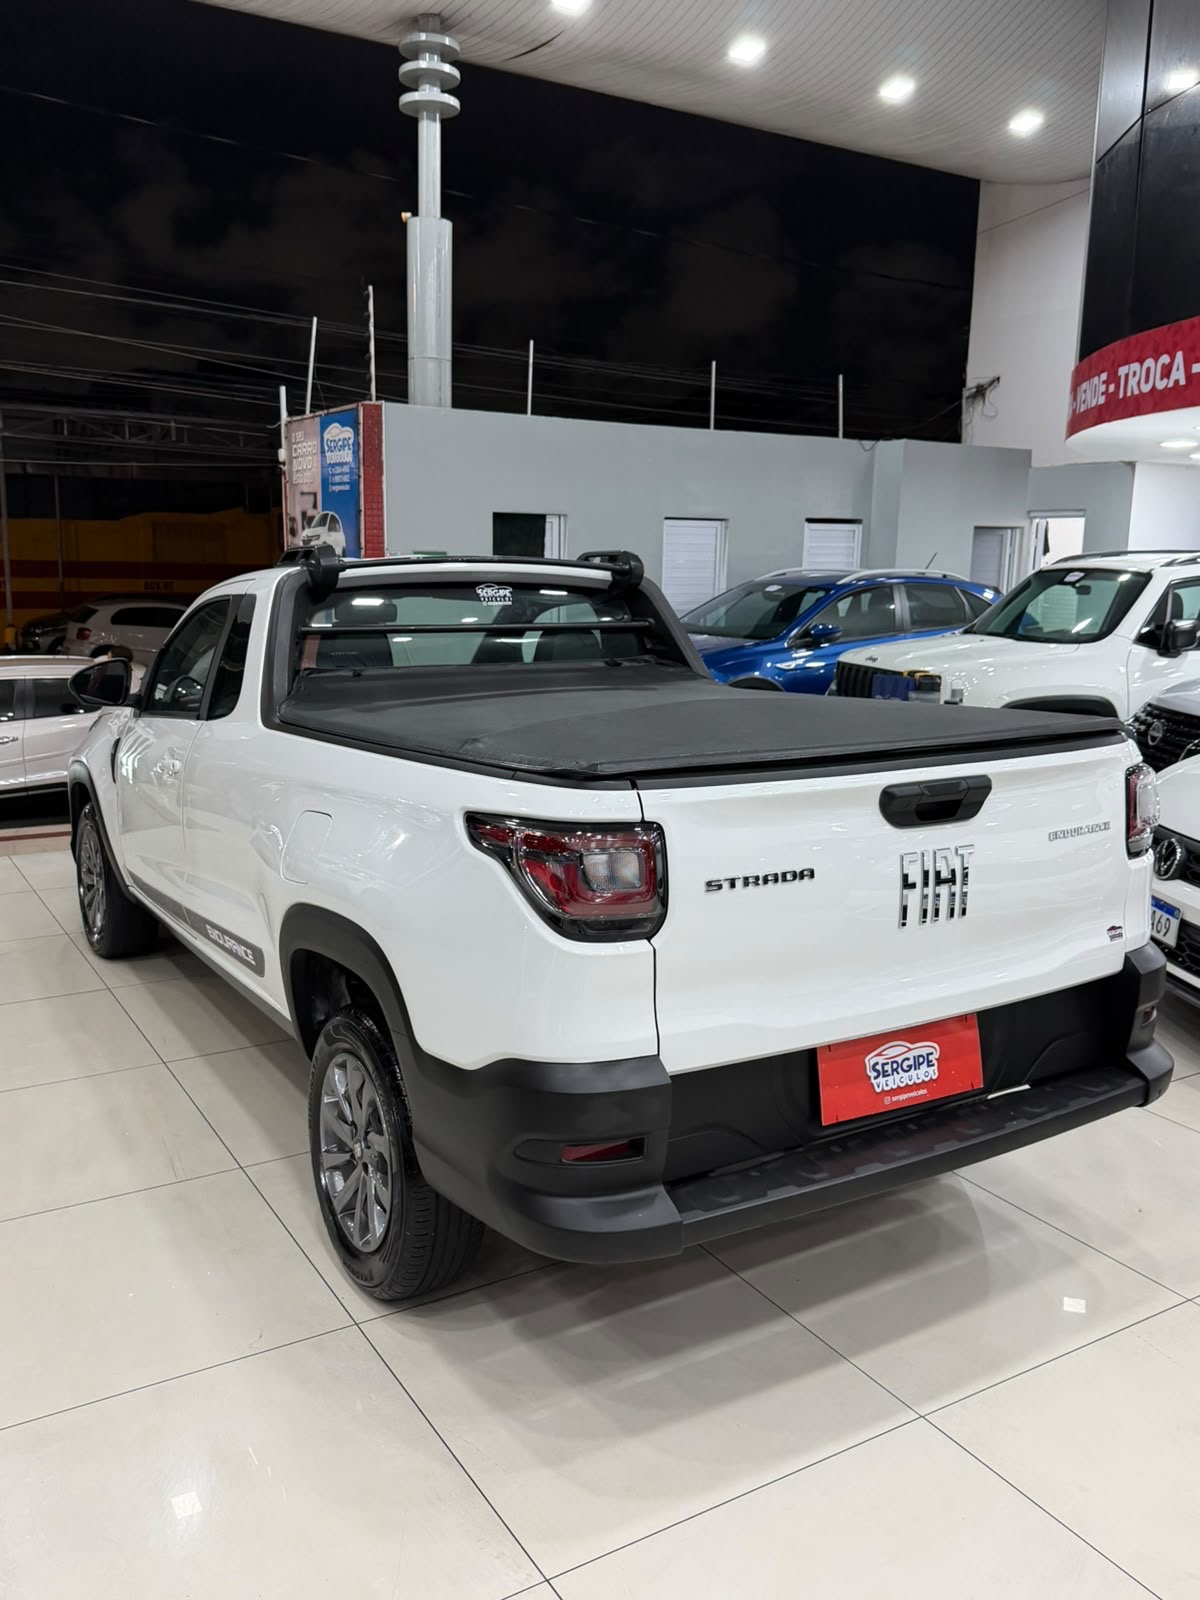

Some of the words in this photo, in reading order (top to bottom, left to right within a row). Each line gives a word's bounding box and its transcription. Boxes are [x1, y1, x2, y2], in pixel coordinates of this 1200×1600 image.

[1118, 350, 1187, 399] TROCA
[292, 440, 318, 457] CARRO
[326, 436, 352, 453] SERGIPE
[293, 456, 313, 472] NOVO
[1048, 820, 1112, 842] ENDURANCE
[704, 867, 816, 892] STRADA
[898, 843, 976, 929] FIAT
[205, 923, 257, 966] ENDURANCE
[871, 1051, 936, 1080] SERGIPE
